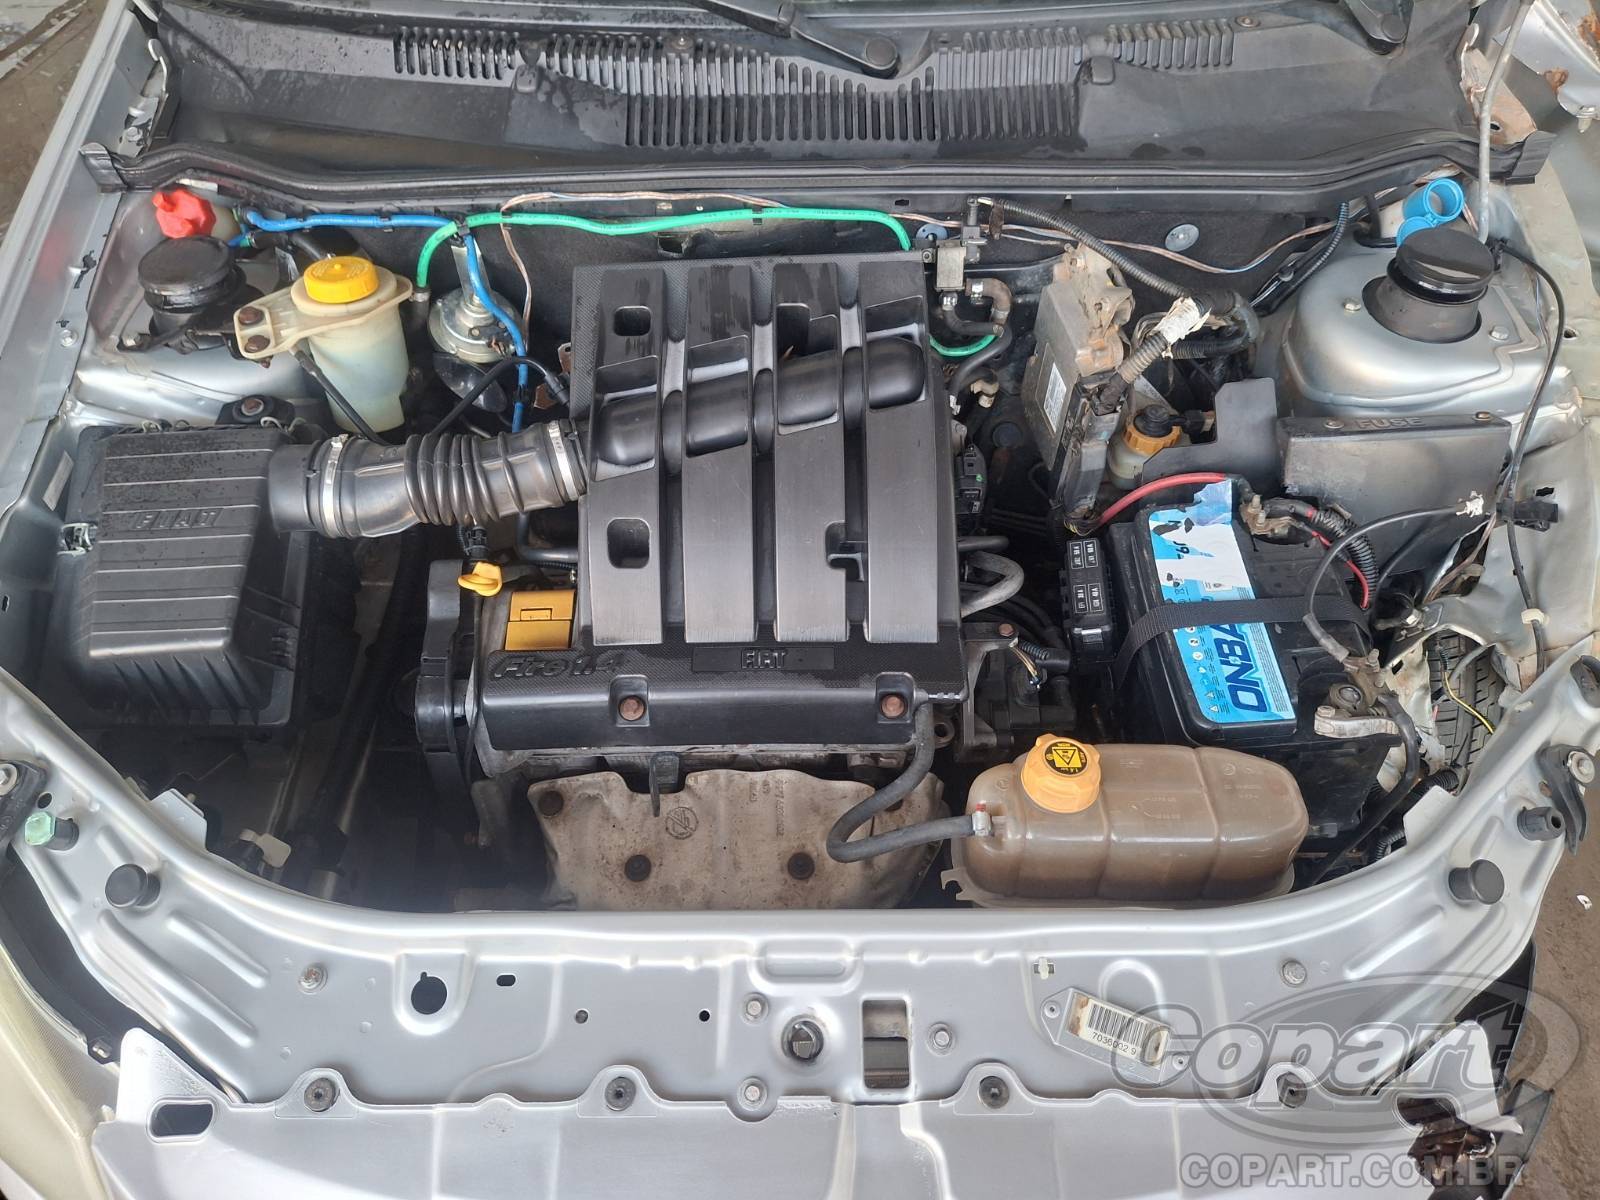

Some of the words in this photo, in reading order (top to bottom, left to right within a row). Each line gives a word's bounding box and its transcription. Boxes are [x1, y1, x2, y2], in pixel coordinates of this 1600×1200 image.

[1356, 416, 1425, 429] FUSE
[130, 508, 222, 529] FIAT
[741, 649, 786, 669] FIAT
